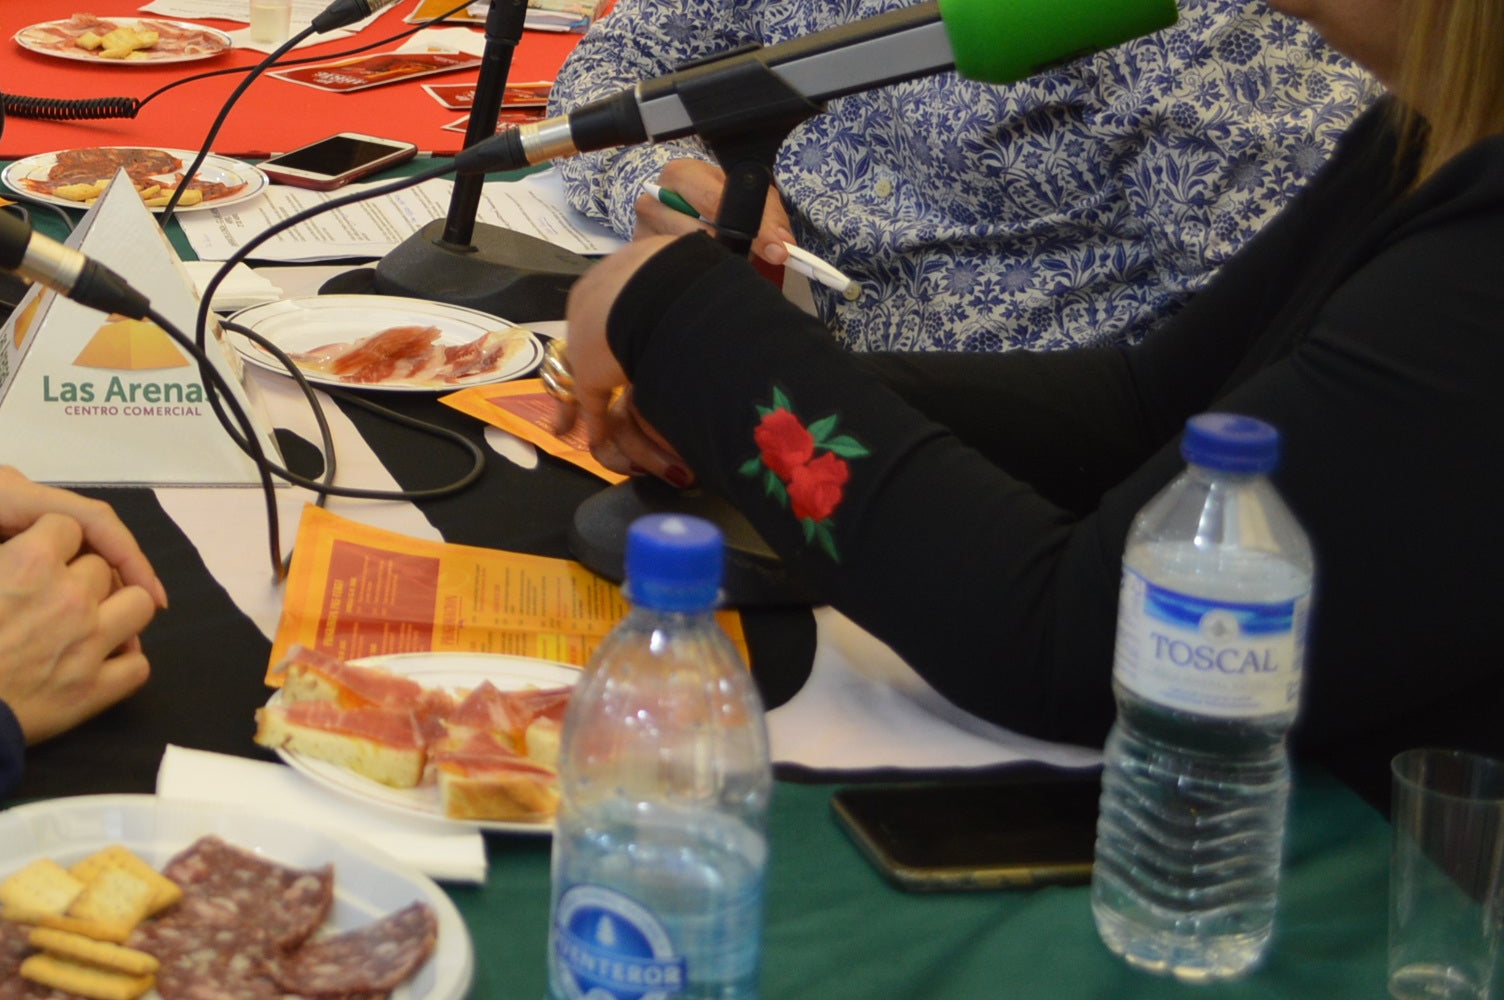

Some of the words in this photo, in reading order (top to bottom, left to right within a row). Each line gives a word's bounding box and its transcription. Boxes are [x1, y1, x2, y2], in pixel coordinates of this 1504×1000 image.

[43, 375, 95, 402] Las
[64, 405, 119, 416] CENTRO
[123, 406, 202, 417] COMERCIAL
[1149, 631, 1280, 675] TOSCAL
